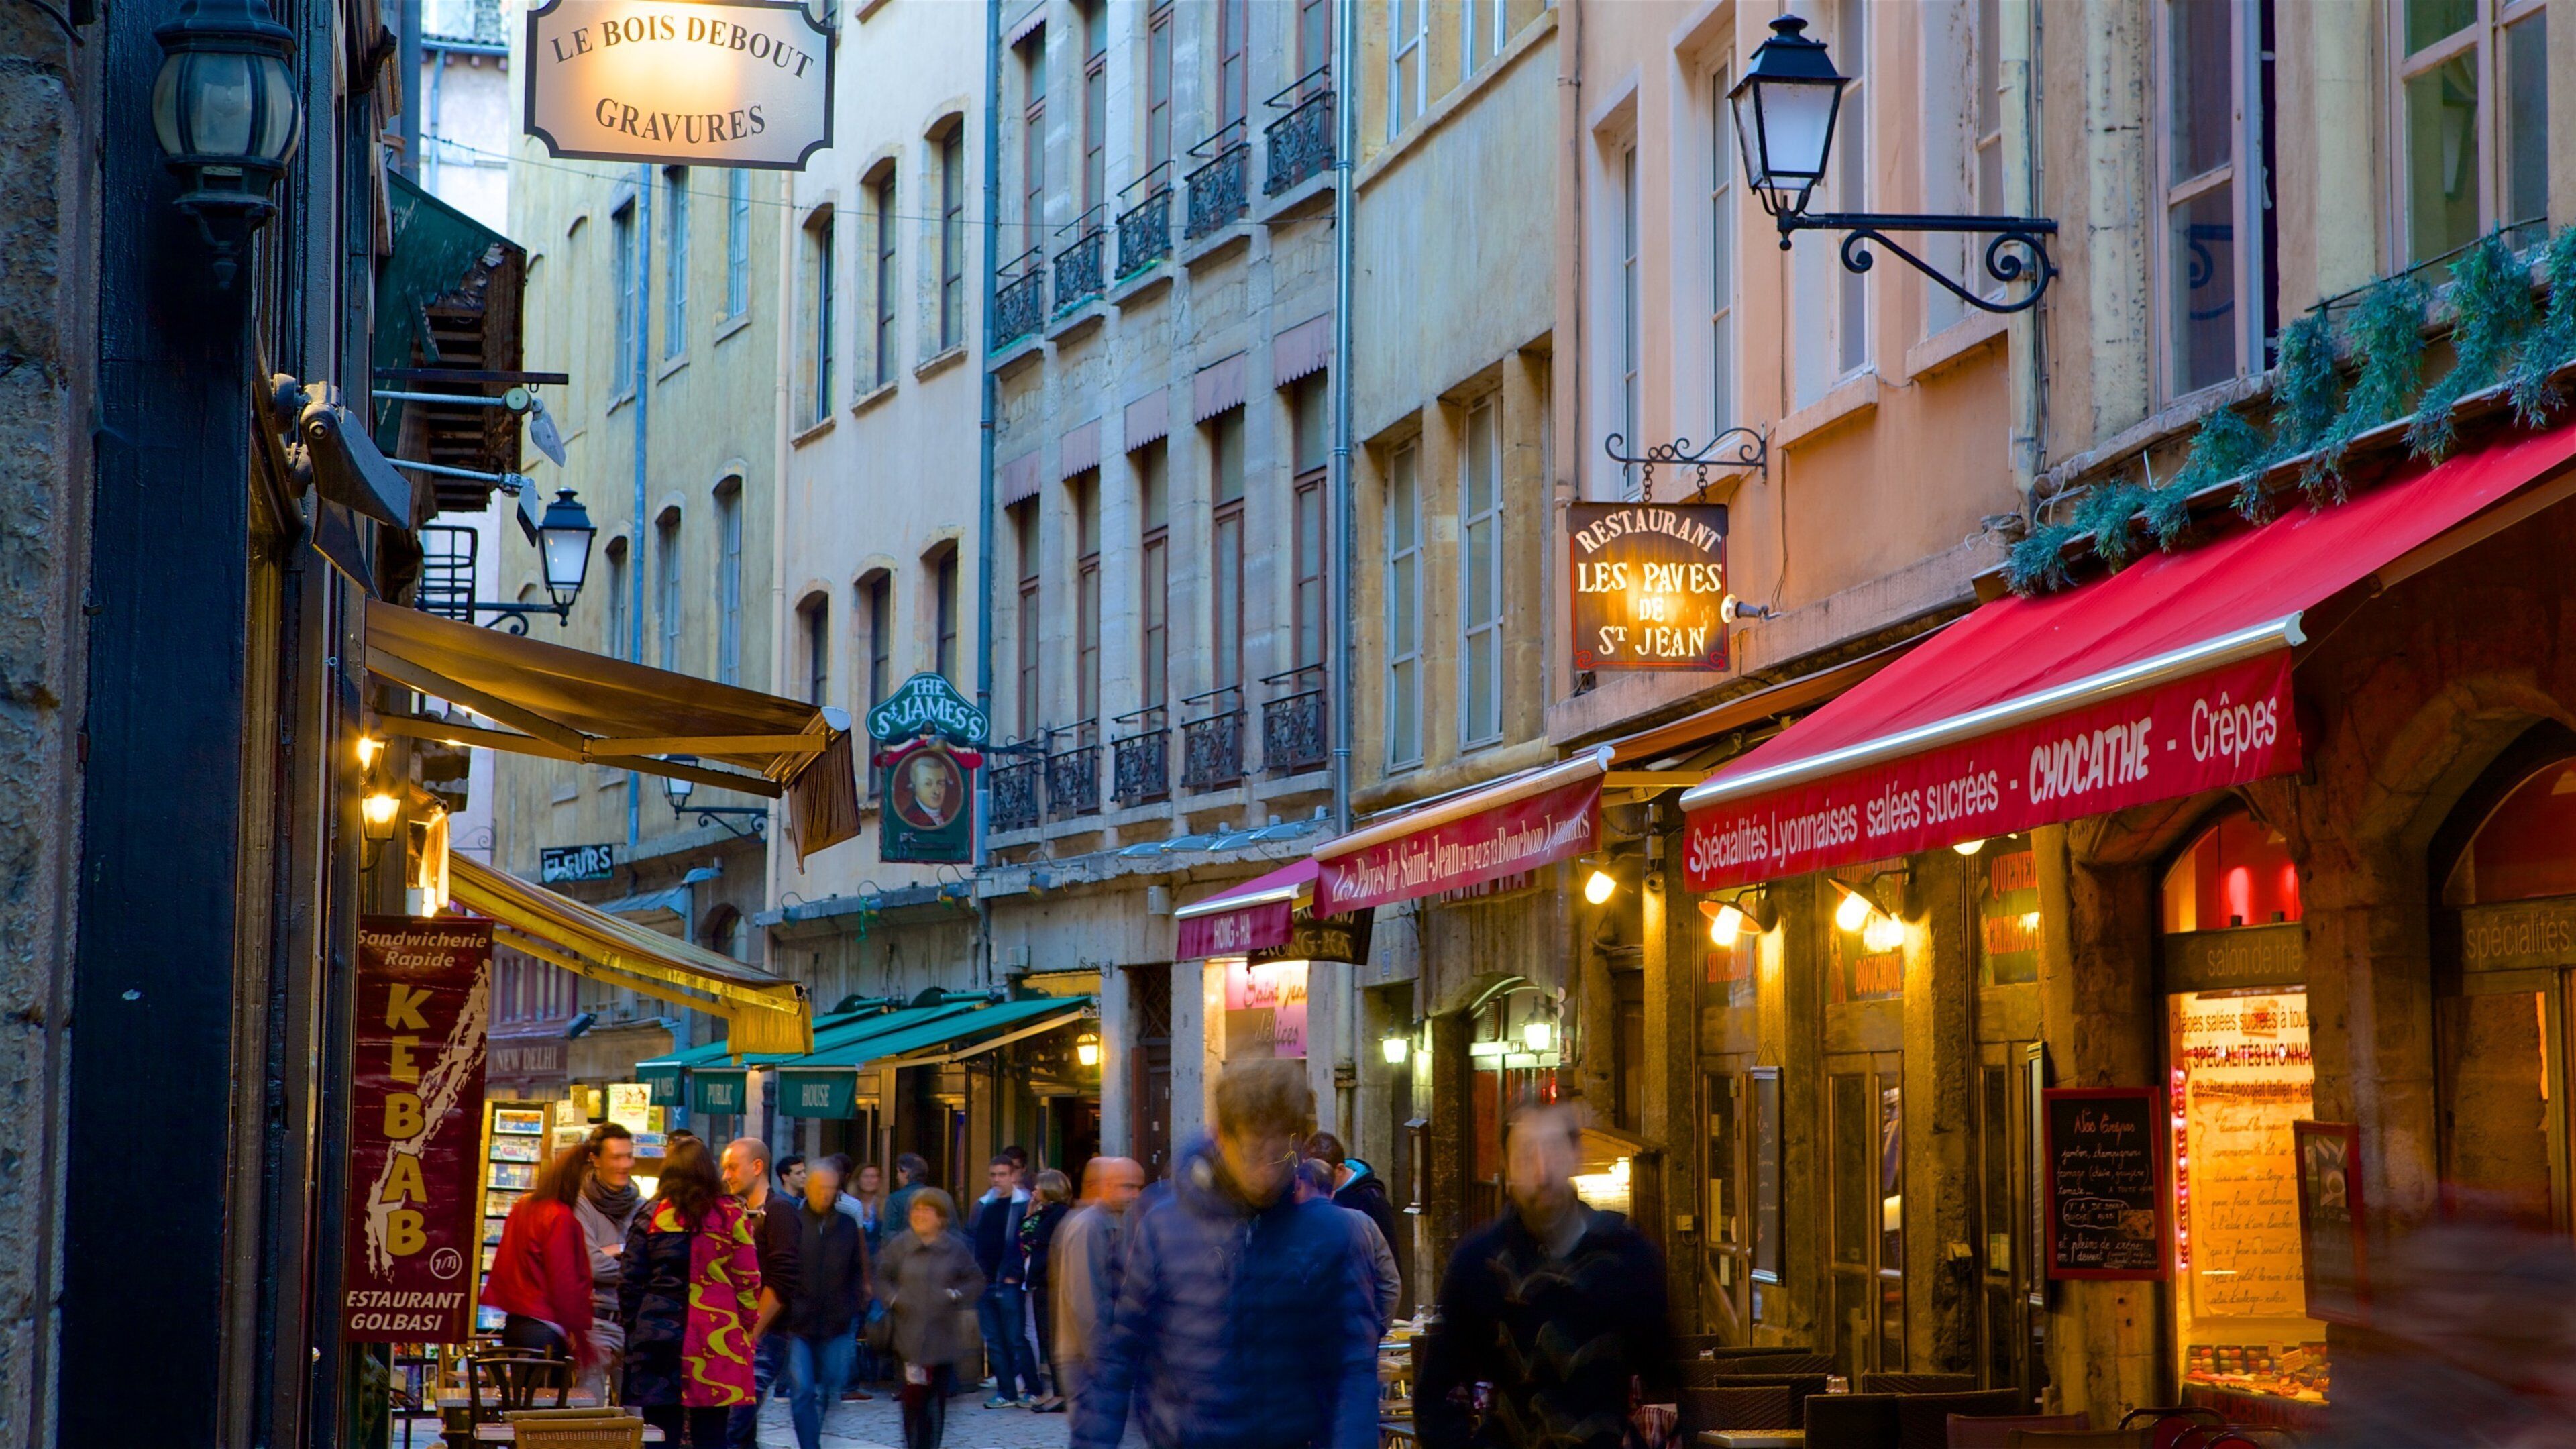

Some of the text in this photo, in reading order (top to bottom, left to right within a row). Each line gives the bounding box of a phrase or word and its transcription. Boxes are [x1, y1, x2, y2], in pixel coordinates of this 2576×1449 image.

[550, 16, 814, 79] LE BOIS DEBOUT
[596, 97, 765, 144] GRAVURES
[1576, 508, 1721, 554] RESTAURANT
[1578, 562, 1722, 594] LES PAVES
[1639, 596, 1665, 621] DE
[1635, 626, 1706, 657] JEAN
[911, 678, 946, 696] THE
[897, 696, 983, 739] JAMES'S
[1689, 814, 1768, 881] Spécialités
[1771, 798, 1858, 868] Lyonnaises
[1866, 780, 1921, 838] salées
[1927, 761, 1998, 825] sucrées
[2029, 716, 2152, 804] CHOCATHE
[2191, 691, 2277, 767] Crêpes
[543, 845, 612, 877] FLEURS
[1332, 864, 1356, 902] Les
[1385, 848, 1398, 893] de
[1400, 834, 1459, 889] Saint-Jean
[1497, 820, 1543, 863] Bouchon
[358, 929, 487, 948] Sandwicherie
[2465, 910, 2571, 969] spécialités
[384, 951, 455, 969] Rapide
[1856, 953, 1901, 995] BOUCHON
[2207, 941, 2247, 977] salon
[2251, 939, 2271, 974] de
[2206, 1009, 2237, 1032] salées
[496, 1046, 557, 1071] NEW DELHI
[2265, 1042, 2313, 1067] LYONNA
[707, 1083, 733, 1106] PUBLIC
[802, 1084, 830, 1107] HOUSE
[380, 982, 434, 1256] KEBAB
[350, 1313, 443, 1331] GOLBASI
